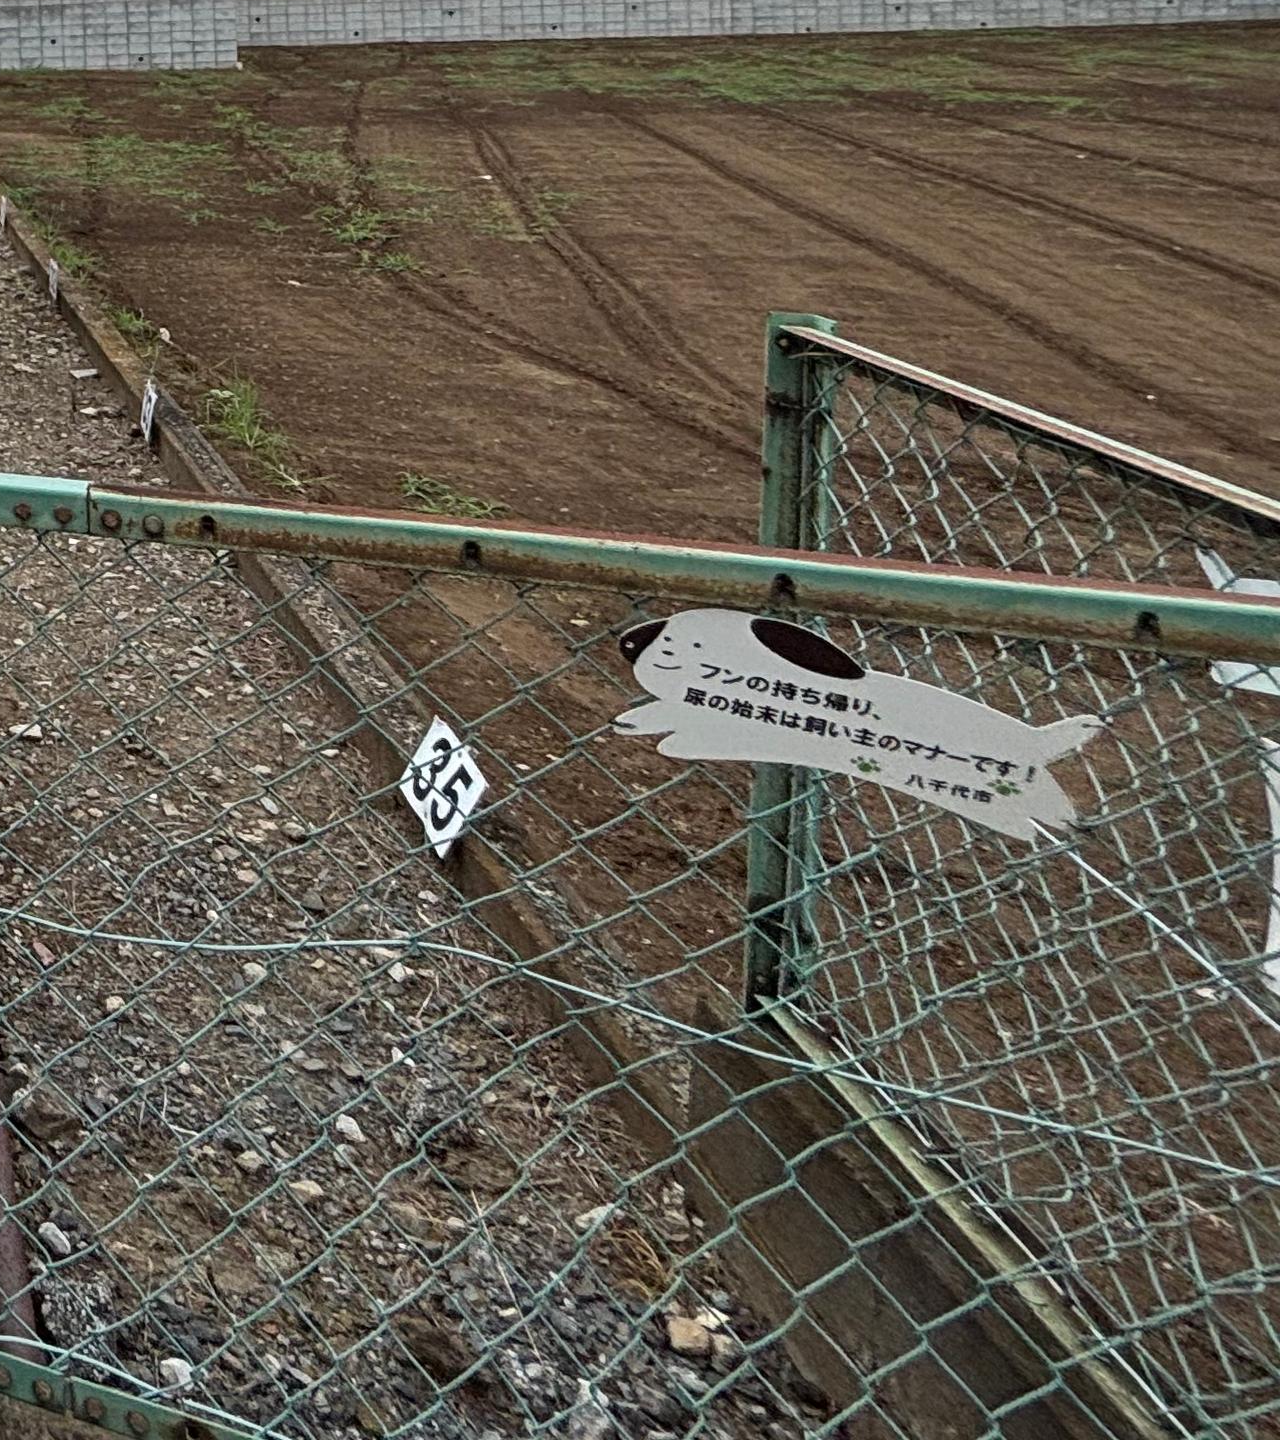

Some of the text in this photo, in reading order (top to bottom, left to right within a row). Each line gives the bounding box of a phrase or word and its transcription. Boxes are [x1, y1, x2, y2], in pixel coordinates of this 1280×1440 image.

[700, 662, 882, 721] フンの持ち帰り、
[904, 773, 995, 804] 八千代市
